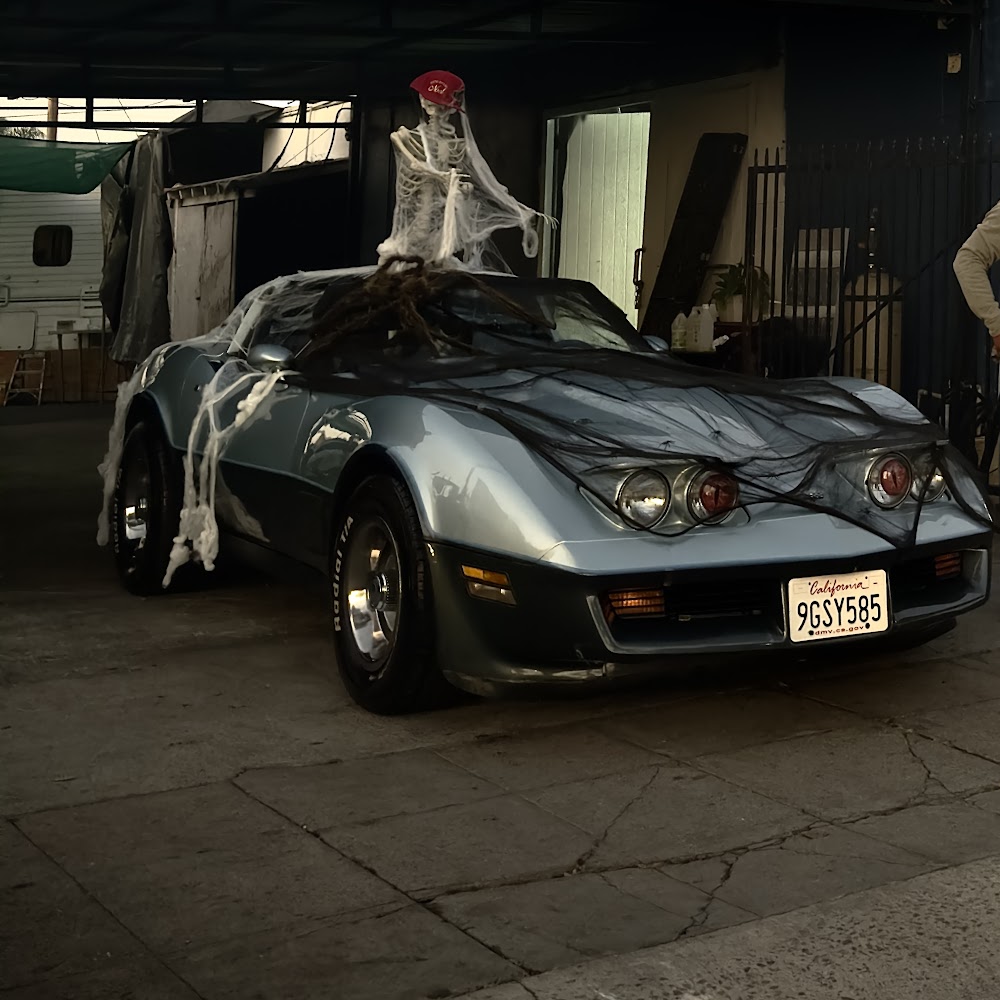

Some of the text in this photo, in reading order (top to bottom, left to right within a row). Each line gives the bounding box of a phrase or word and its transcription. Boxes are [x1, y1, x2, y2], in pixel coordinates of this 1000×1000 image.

[332, 516, 354, 632] Radial T/A
[809, 579, 869, 597] California
[797, 594, 881, 631] 9GSY585
[815, 625, 864, 635] dmv.ca.gov
